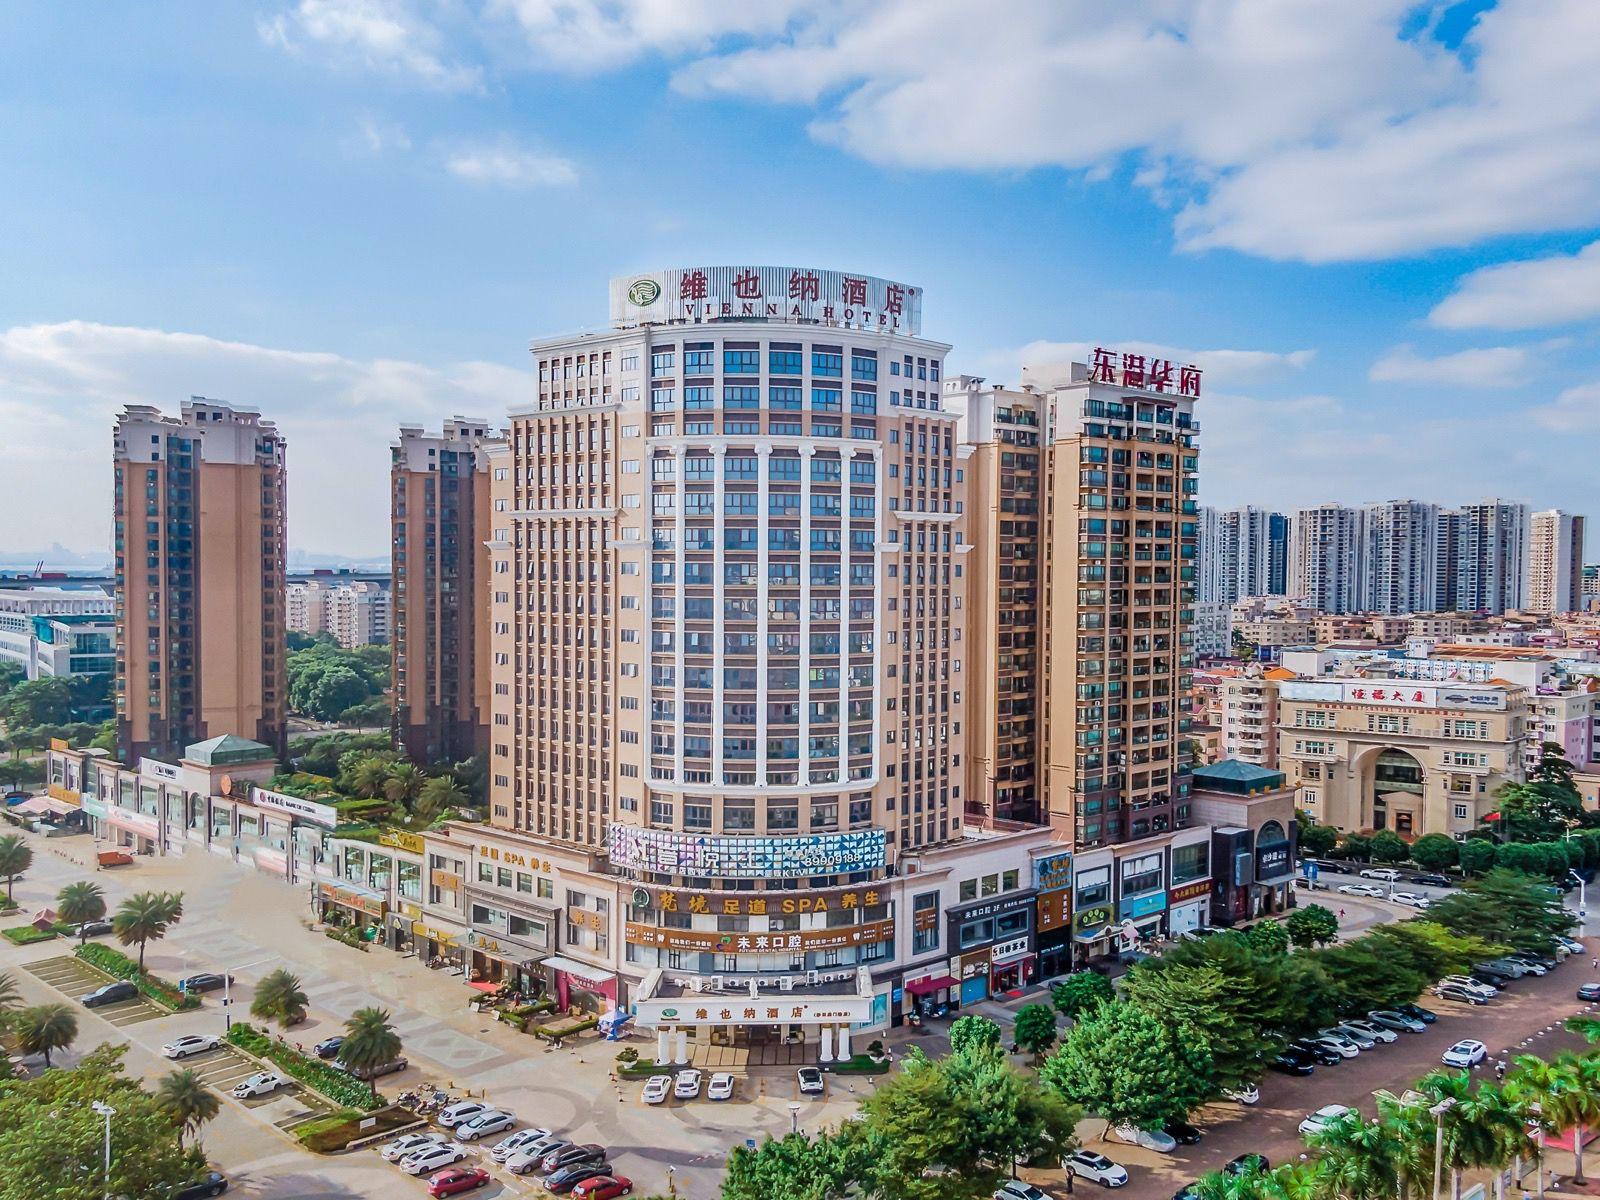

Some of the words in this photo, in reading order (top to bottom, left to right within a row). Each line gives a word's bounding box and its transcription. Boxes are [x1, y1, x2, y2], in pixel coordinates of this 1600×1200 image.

[680, 269, 905, 315] 维也纳酒店
[685, 303, 802, 315] VIENNA
[822, 306, 900, 328] HOTEL
[504, 851, 525, 866] SPA
[805, 853, 861, 867] 89909188
[782, 869, 806, 877] KTV
[782, 897, 829, 914] SPA
[841, 890, 879, 908] 养生
[737, 935, 802, 949] 未来口腔
[696, 1006, 803, 1019] 维也纳酒店
